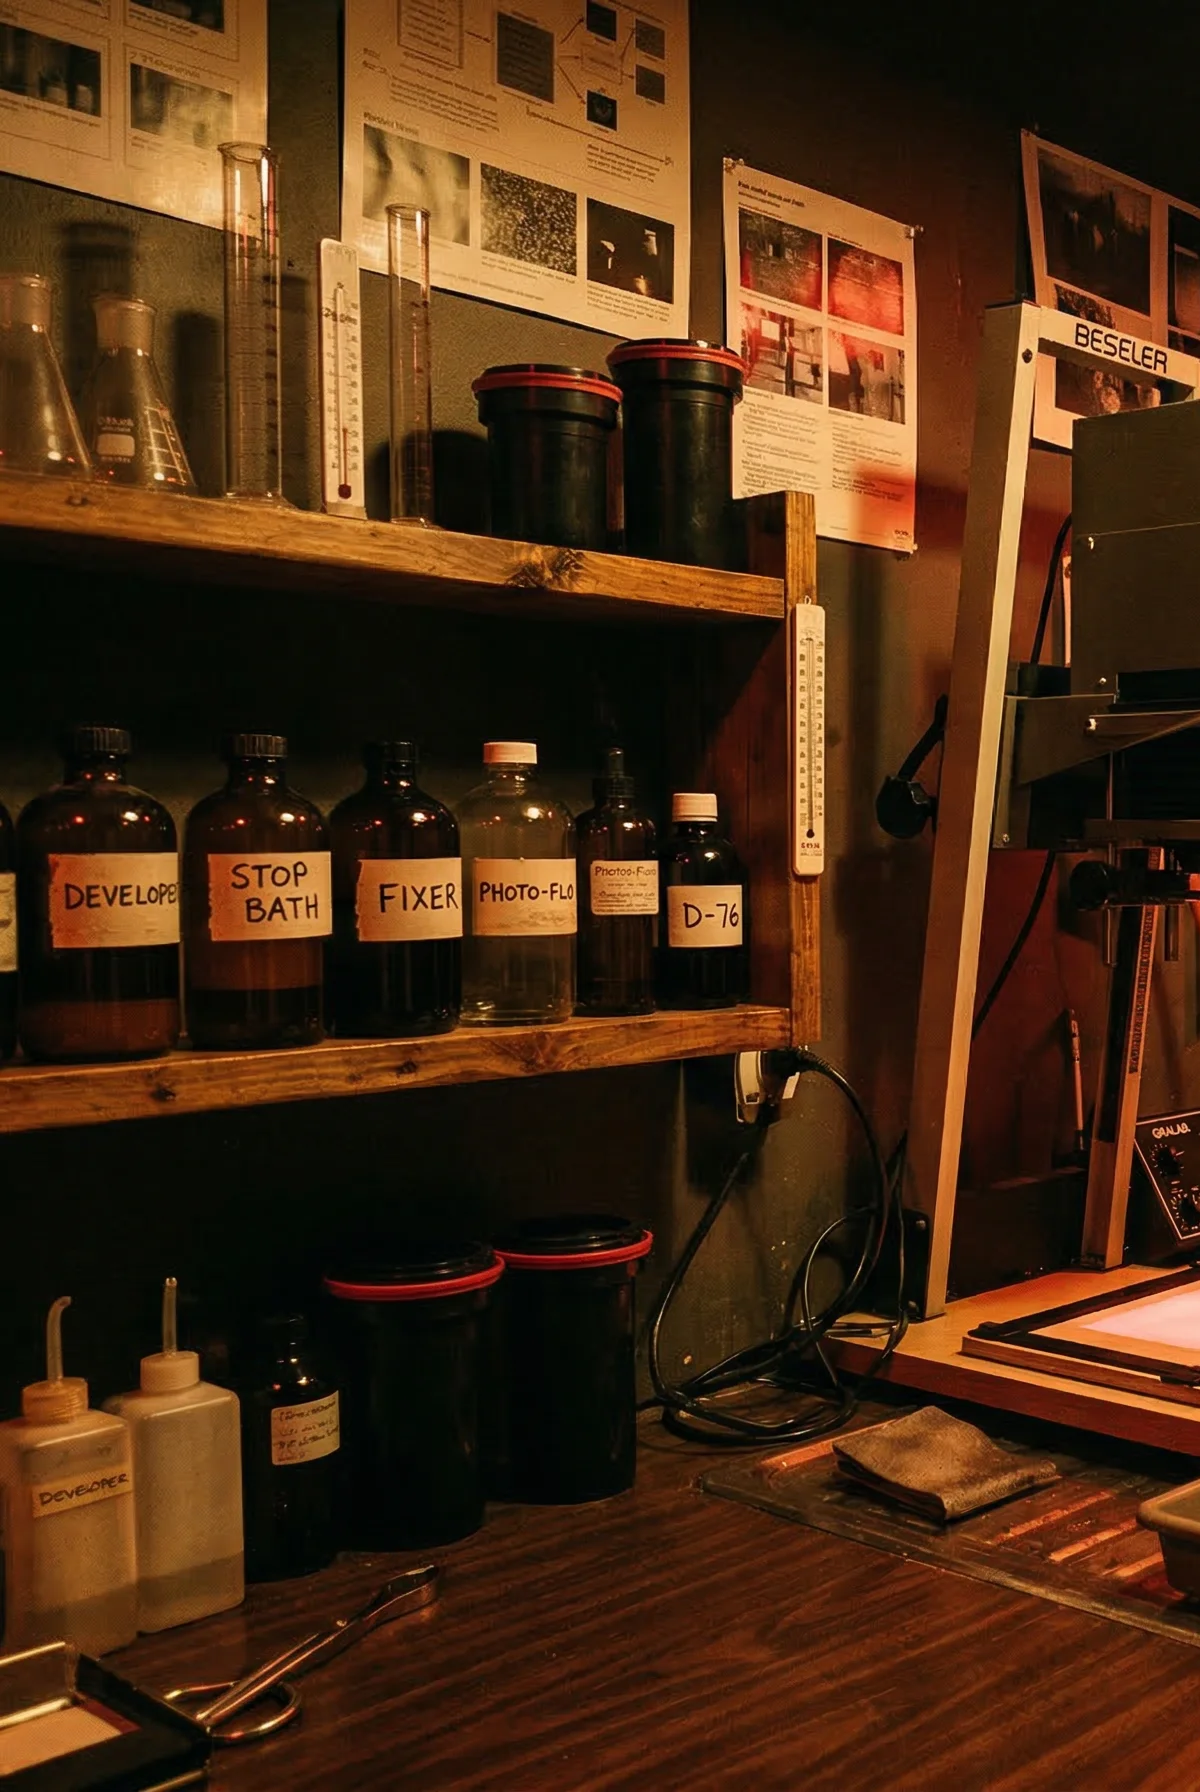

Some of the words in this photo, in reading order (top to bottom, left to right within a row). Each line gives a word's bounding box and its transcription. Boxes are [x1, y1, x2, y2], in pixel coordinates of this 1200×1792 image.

[1075, 323, 1168, 374] BESELER
[231, 861, 308, 889] STOP
[65, 881, 180, 910] DEVELOPE
[379, 883, 459, 913] FIXER
[480, 881, 574, 902] PHOTO-FLO
[245, 893, 319, 923] BATH
[683, 902, 739, 928] D-76
[39, 1473, 129, 1506] DEVELOPER
